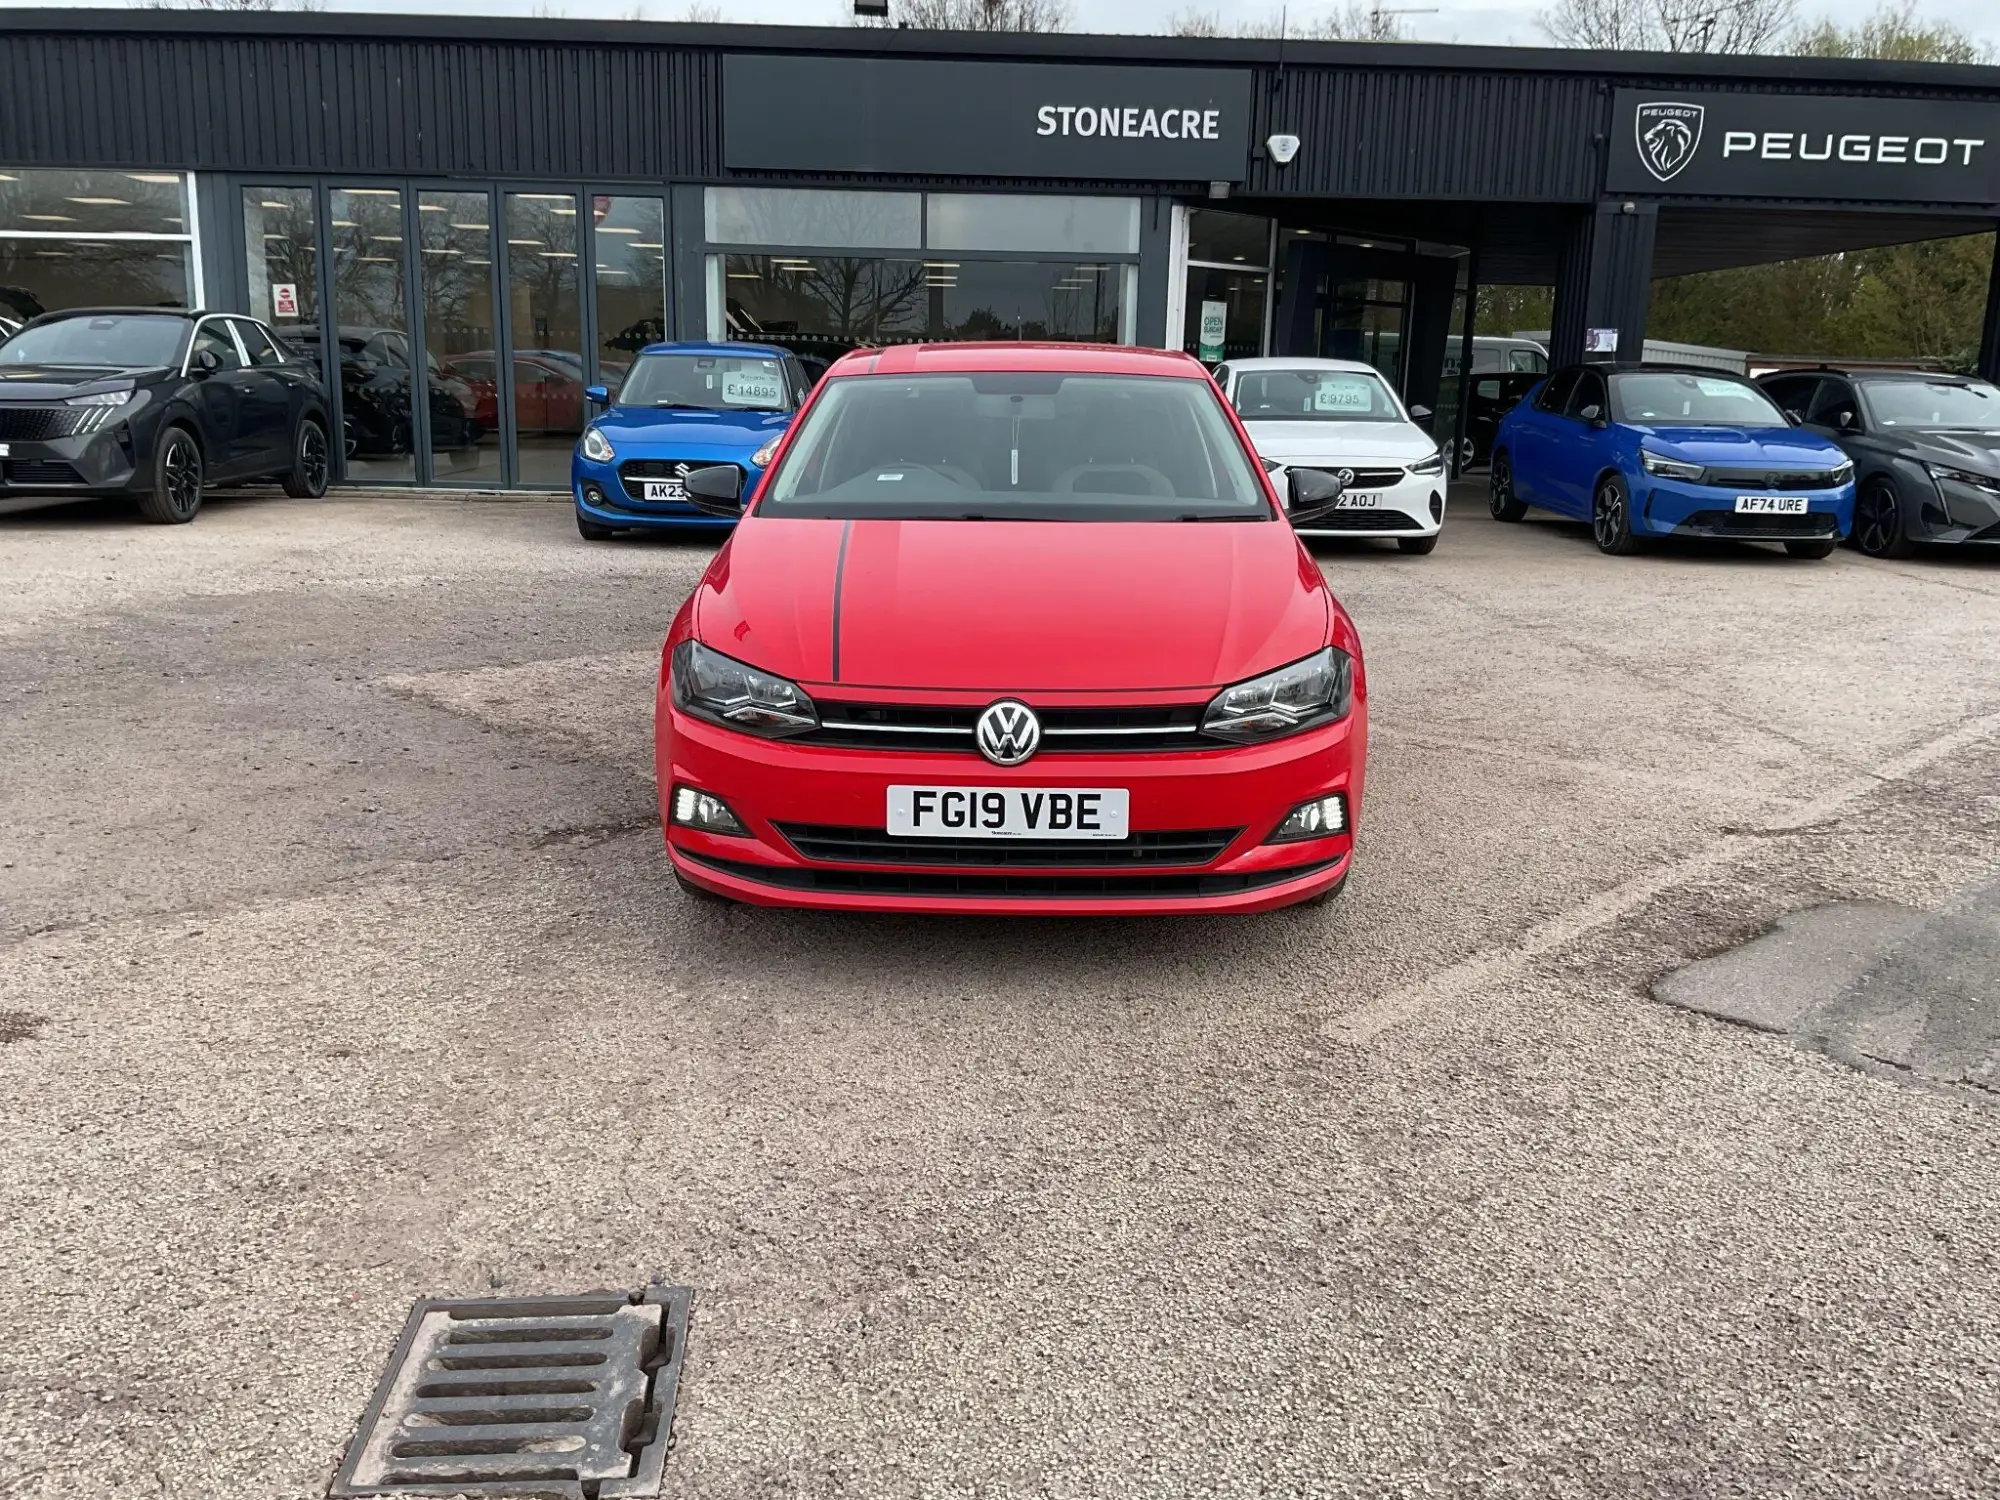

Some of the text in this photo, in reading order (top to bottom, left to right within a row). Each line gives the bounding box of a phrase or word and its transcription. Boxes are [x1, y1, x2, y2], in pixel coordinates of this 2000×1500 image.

[1642, 108, 1698, 119] PEUGEOT
[1036, 105, 1220, 140] STONEACRE
[1723, 131, 1985, 166] PEUGEOT
[1204, 316, 1223, 326] OPEN
[651, 485, 685, 497] AK23
[1350, 494, 1376, 507] AOJ
[1741, 498, 1803, 511] AF74 URE
[913, 790, 1102, 830] FG19 VBE
